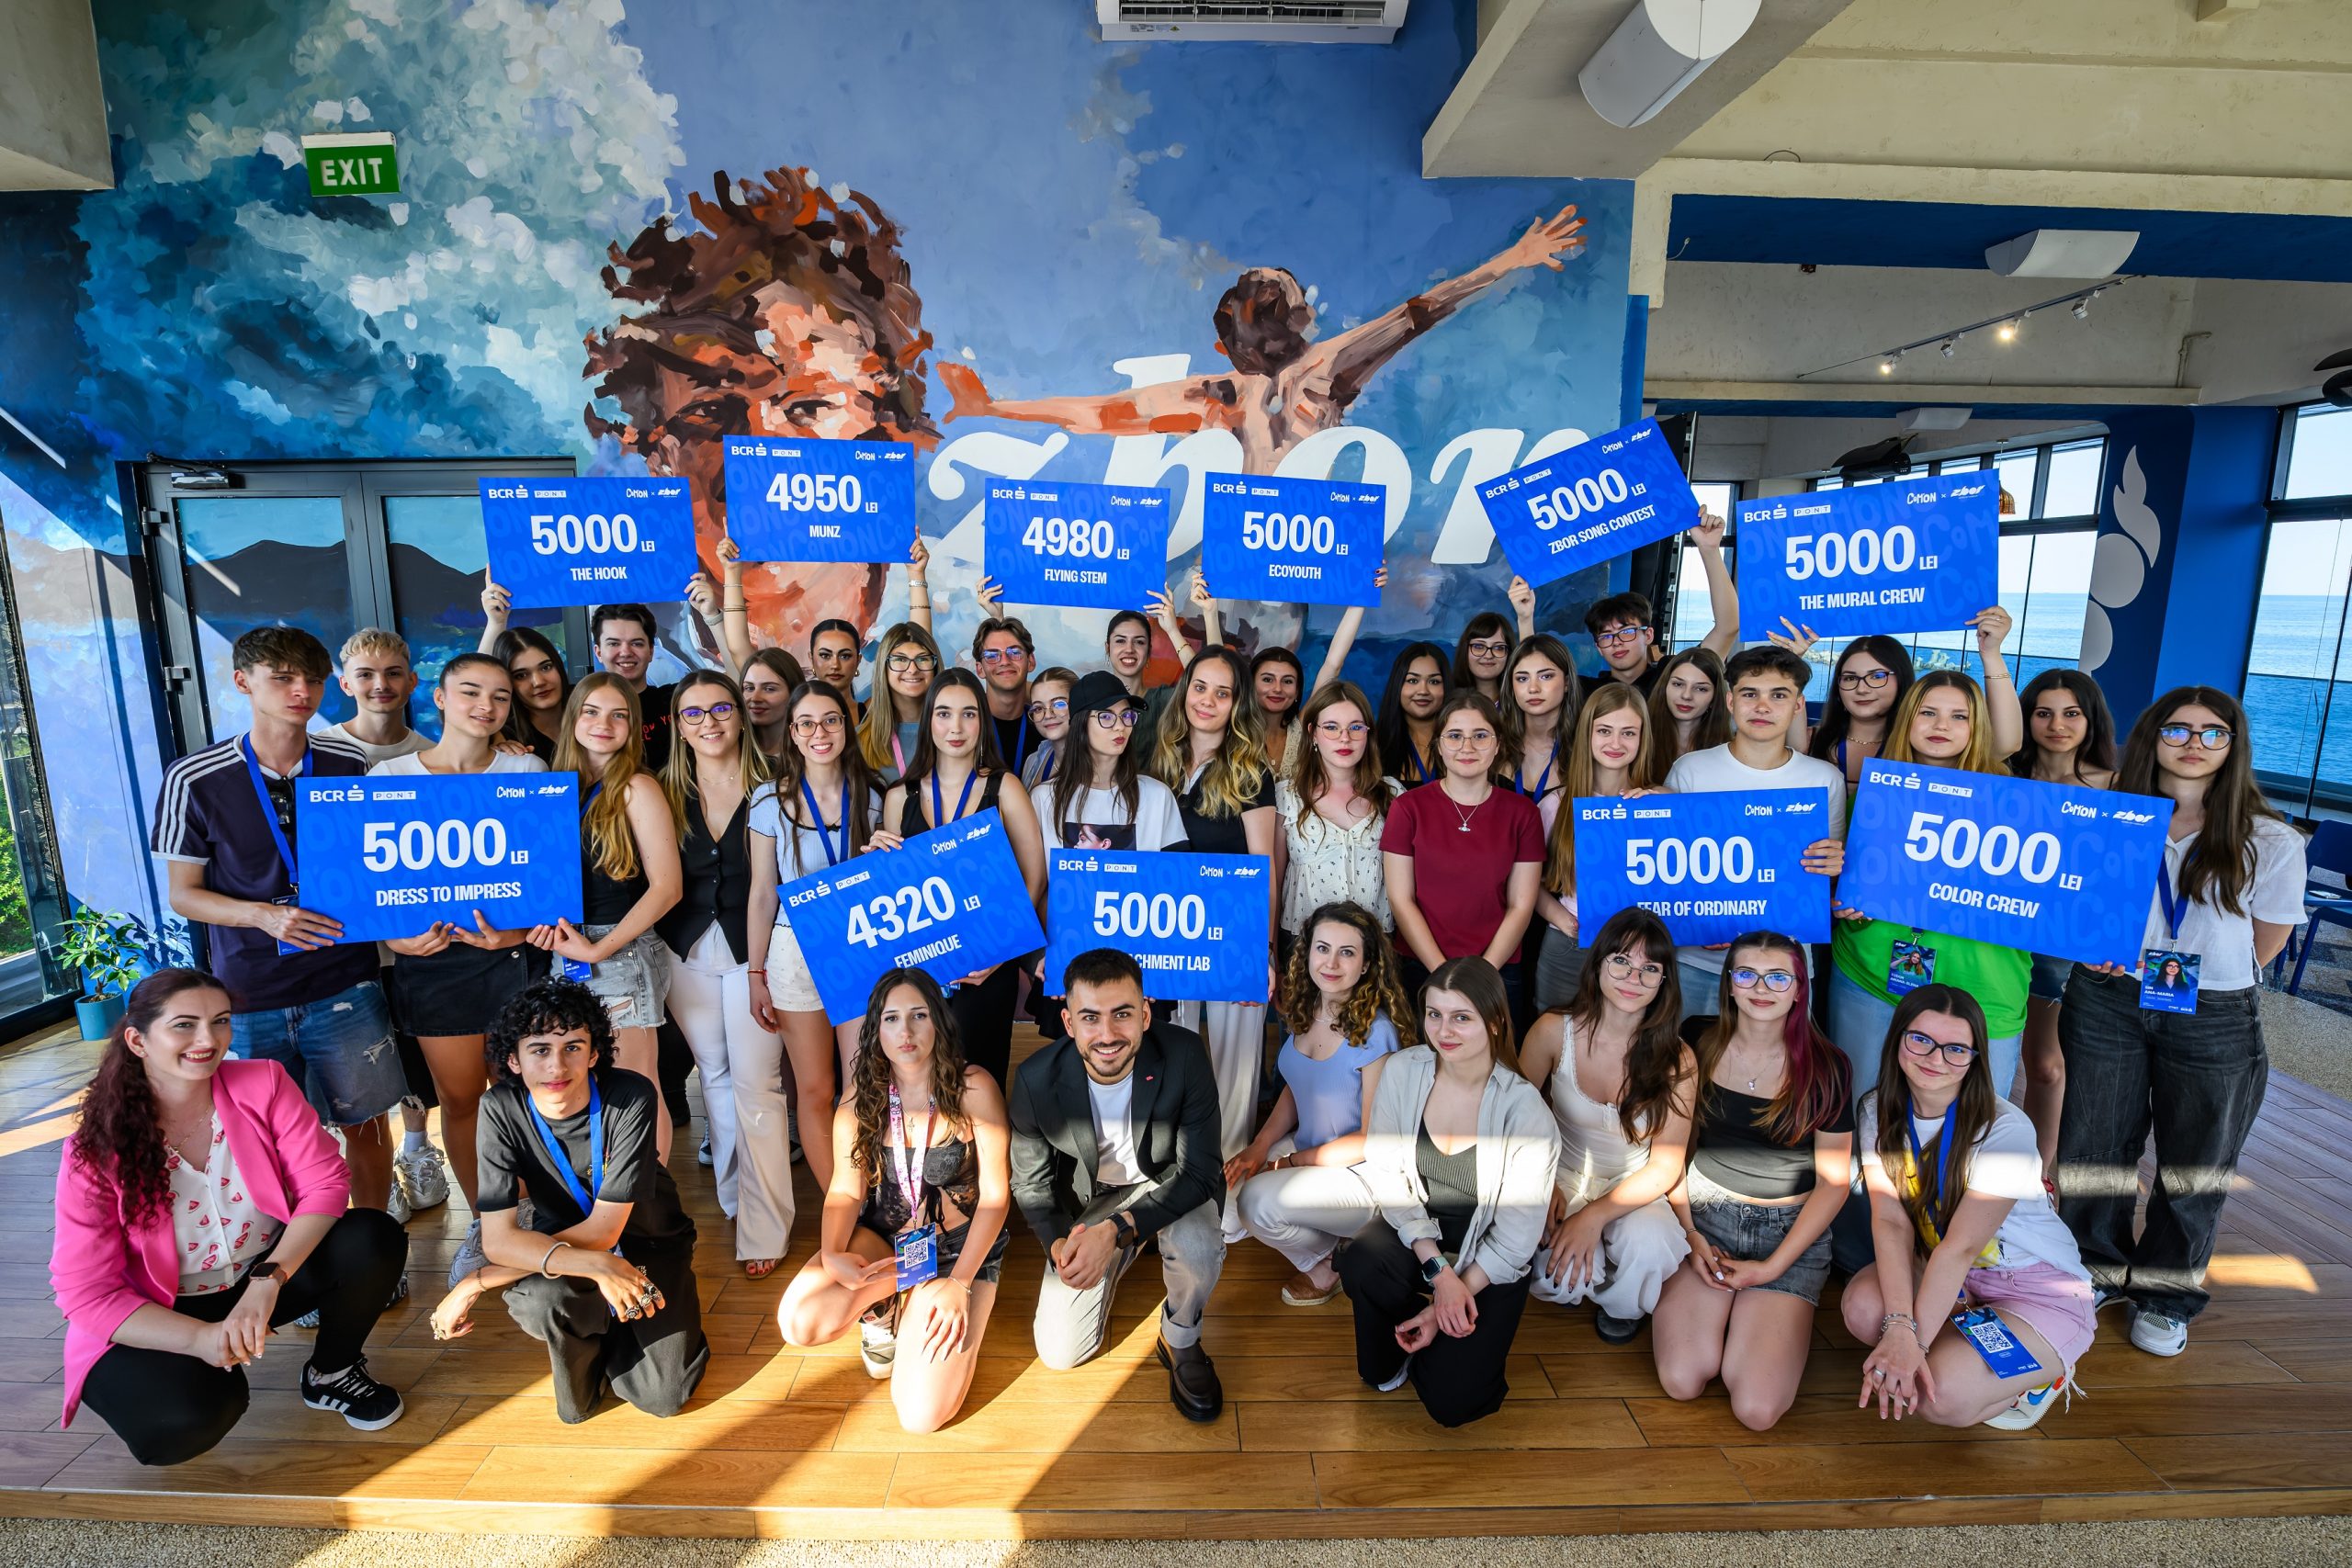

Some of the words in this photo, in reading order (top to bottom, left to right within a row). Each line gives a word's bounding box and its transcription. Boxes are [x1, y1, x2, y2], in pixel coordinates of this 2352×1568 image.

[320, 157, 382, 186] EXIT
[731, 446, 753, 456] BCR
[489, 489, 514, 499] BCR
[766, 473, 862, 513] 4950
[865, 502, 878, 513] LEI
[992, 489, 1013, 499] BCR
[1213, 483, 1234, 493] BCR
[1486, 484, 1508, 499] BCR
[1527, 468, 1627, 530] 5000
[1631, 483, 1646, 496] LEI
[1744, 511, 1771, 523] BCR
[531, 514, 638, 555] 5000
[641, 540, 655, 552] LEI
[809, 525, 841, 537] MUNZ
[1023, 517, 1114, 558] 4980
[1117, 548, 1130, 559] LEI
[1242, 511, 1335, 554] 5000
[1336, 544, 1348, 556] LEI
[1548, 535, 1579, 554] ZBOR
[1579, 523, 1610, 543] SONG
[1609, 504, 1656, 530] CONTEST
[1786, 525, 1916, 581] 5000
[1919, 556, 1938, 570] LEI
[571, 568, 593, 581] THE
[594, 566, 627, 581] HOOK
[1045, 569, 1078, 582] FLYING
[1080, 570, 1107, 584] STEM
[1269, 565, 1321, 579] ECOYOUTH
[1800, 595, 1824, 610] THE
[1827, 592, 1877, 608] MURAL
[1880, 587, 1925, 604] CREW
[1870, 771, 1902, 787] BCR
[310, 790, 345, 802] BCR
[1582, 808, 1610, 820] BCR
[363, 818, 507, 872] 5000
[511, 851, 529, 864] LEI
[1904, 811, 2061, 884] 5000
[2059, 873, 2083, 891] LEI
[1058, 860, 1083, 872] BCR
[1626, 836, 1754, 885] 5000
[1758, 869, 1775, 883] LEI
[376, 887, 428, 907] DRESS
[431, 886, 451, 902] TO
[455, 882, 521, 901] IMPRESS
[788, 890, 817, 907] BCR
[1929, 883, 1984, 908] COLOR
[1985, 894, 2040, 919] CREW
[847, 876, 956, 948] 4320
[964, 895, 981, 912] LEI
[1093, 891, 1204, 939] 5000
[1207, 927, 1222, 940] LEI
[1674, 901, 1690, 917] OF
[1694, 899, 1767, 916] ORDINARY
[894, 934, 962, 968] FEMINIQUE
[1129, 953, 1185, 971] CHMENT
[1187, 956, 1210, 971] LAB
